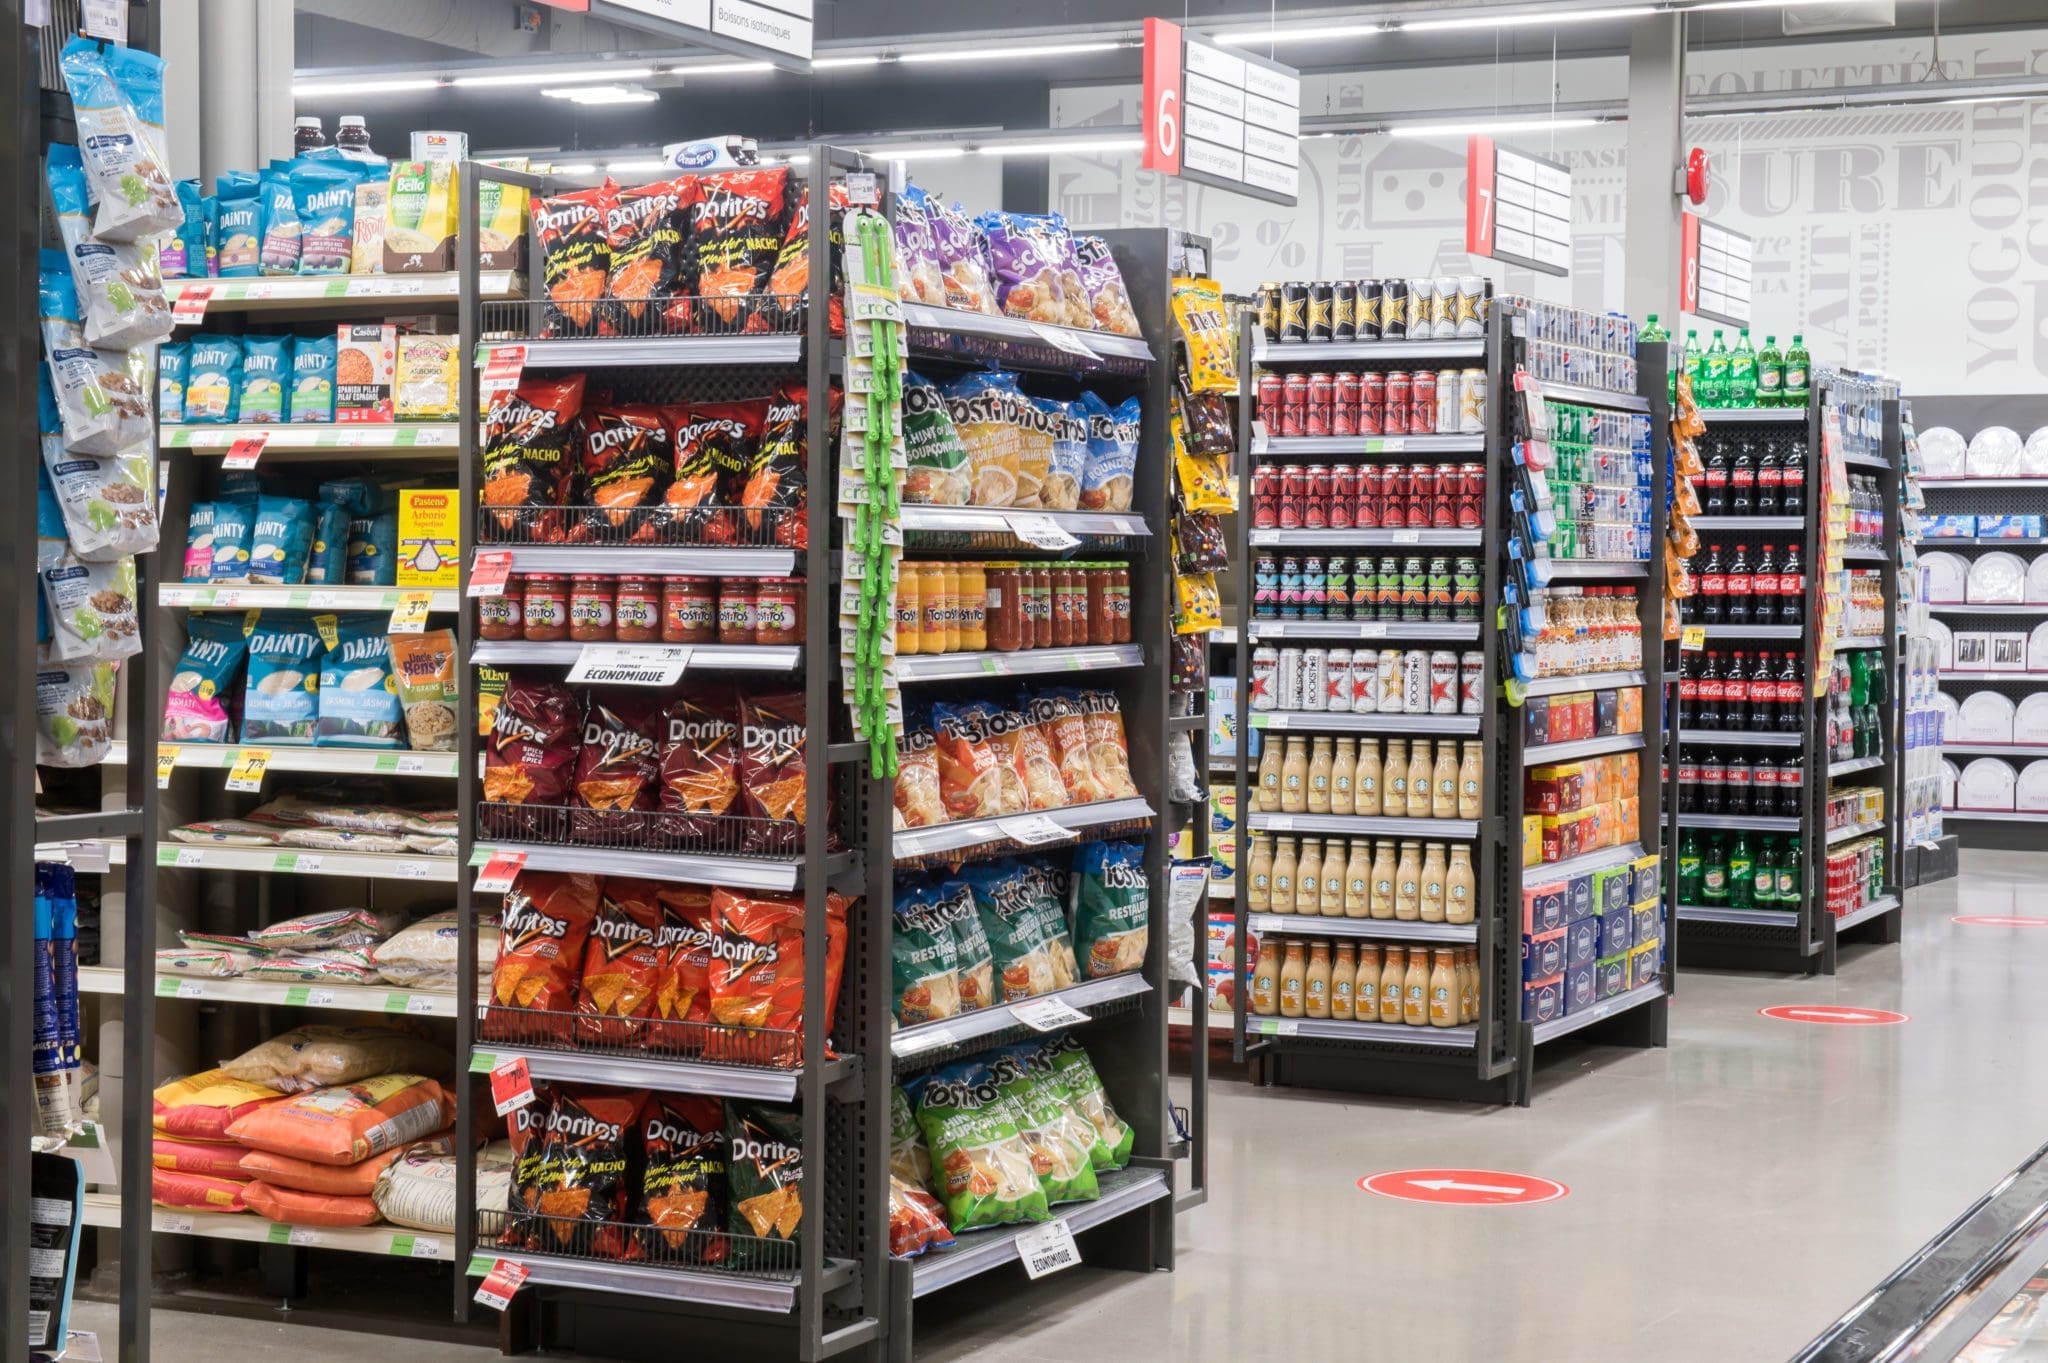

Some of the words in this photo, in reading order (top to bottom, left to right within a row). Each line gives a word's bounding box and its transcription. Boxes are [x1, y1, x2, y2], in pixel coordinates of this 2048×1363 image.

[718, 7, 749, 28] Boissons
[750, 17, 791, 41] isotoniques
[1158, 89, 1176, 157] 6
[427, 135, 447, 146] Dole
[677, 154, 696, 165] Ocean
[697, 151, 715, 165] Spray
[397, 177, 425, 193] Bello
[1480, 188, 1490, 241] 7
[747, 238, 778, 251] NACHO
[1687, 258, 1696, 301] 8
[857, 302, 894, 317] croc
[352, 327, 380, 338] Casbah
[337, 385, 361, 393] SPANISH
[363, 385, 379, 393] PILAF
[337, 393, 352, 401] PILAF
[522, 447, 561, 463] NACHO
[413, 496, 446, 507] Pastene
[412, 509, 447, 520] Arborio
[408, 651, 433, 663] Uncle
[584, 668, 665, 683] ÉCONOMIQUE
[416, 683, 440, 692] GRAINS
[444, 684, 456, 692] 25
[1680, 769, 1696, 779] Coke
[1704, 770, 1722, 780] Coke
[1758, 771, 1777, 782] Coke
[1542, 792, 1554, 802] 12
[1543, 840, 1554, 850] 12
[1680, 862, 1699, 876] Sprite
[1731, 864, 1750, 879] Sprite
[711, 935, 778, 962] Doritos
[589, 1159, 626, 1173] NACHO
[1032, 1248, 1073, 1274] ÉCONOMIQUE
